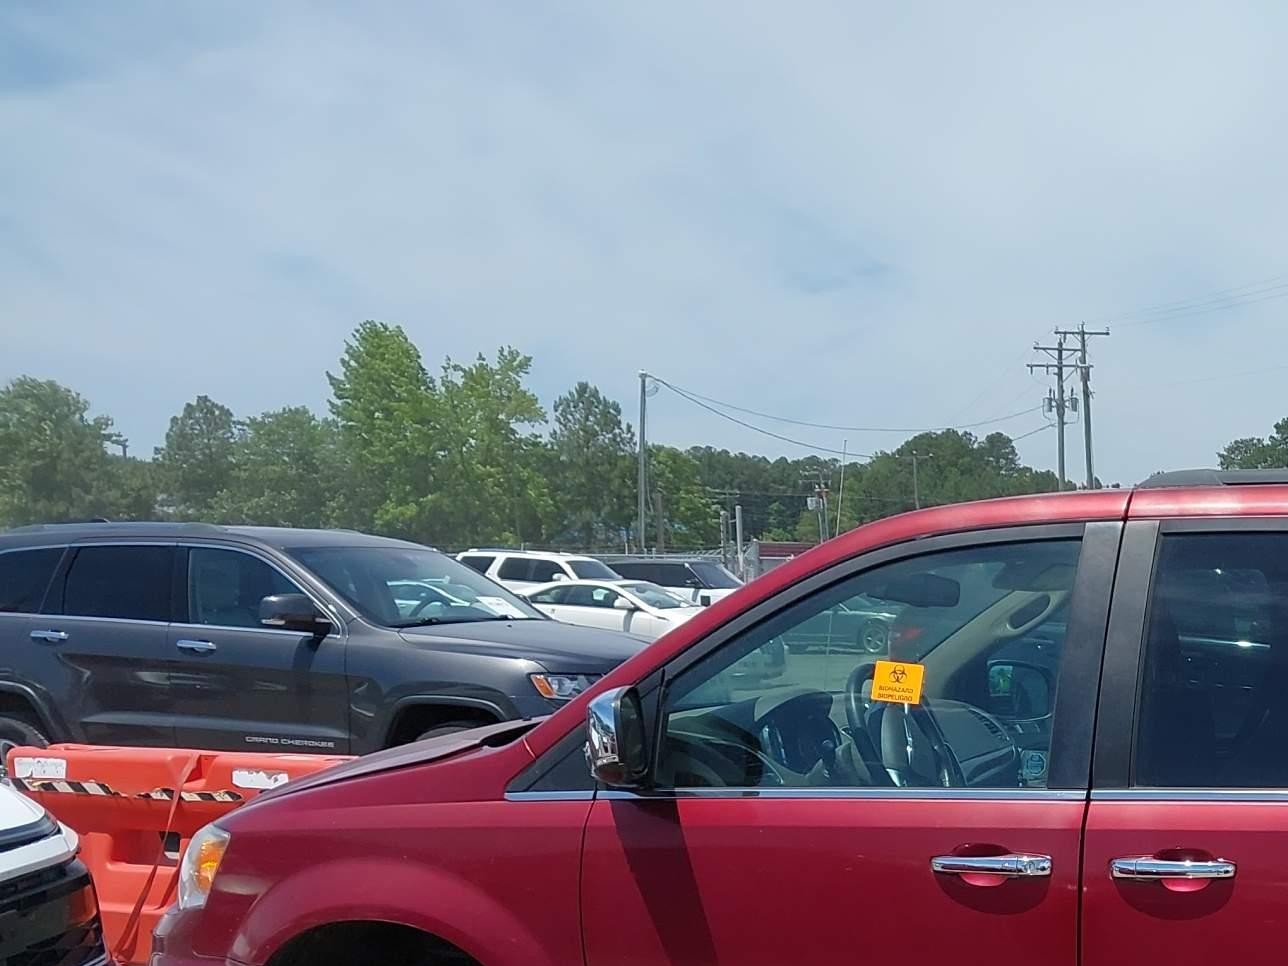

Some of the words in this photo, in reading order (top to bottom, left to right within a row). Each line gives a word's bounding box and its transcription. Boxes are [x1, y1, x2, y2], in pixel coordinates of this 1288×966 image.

[878, 685, 913, 693] BIOHAZARD
[245, 736, 279, 744] GRAND
[280, 738, 335, 748] CHEROKEE
